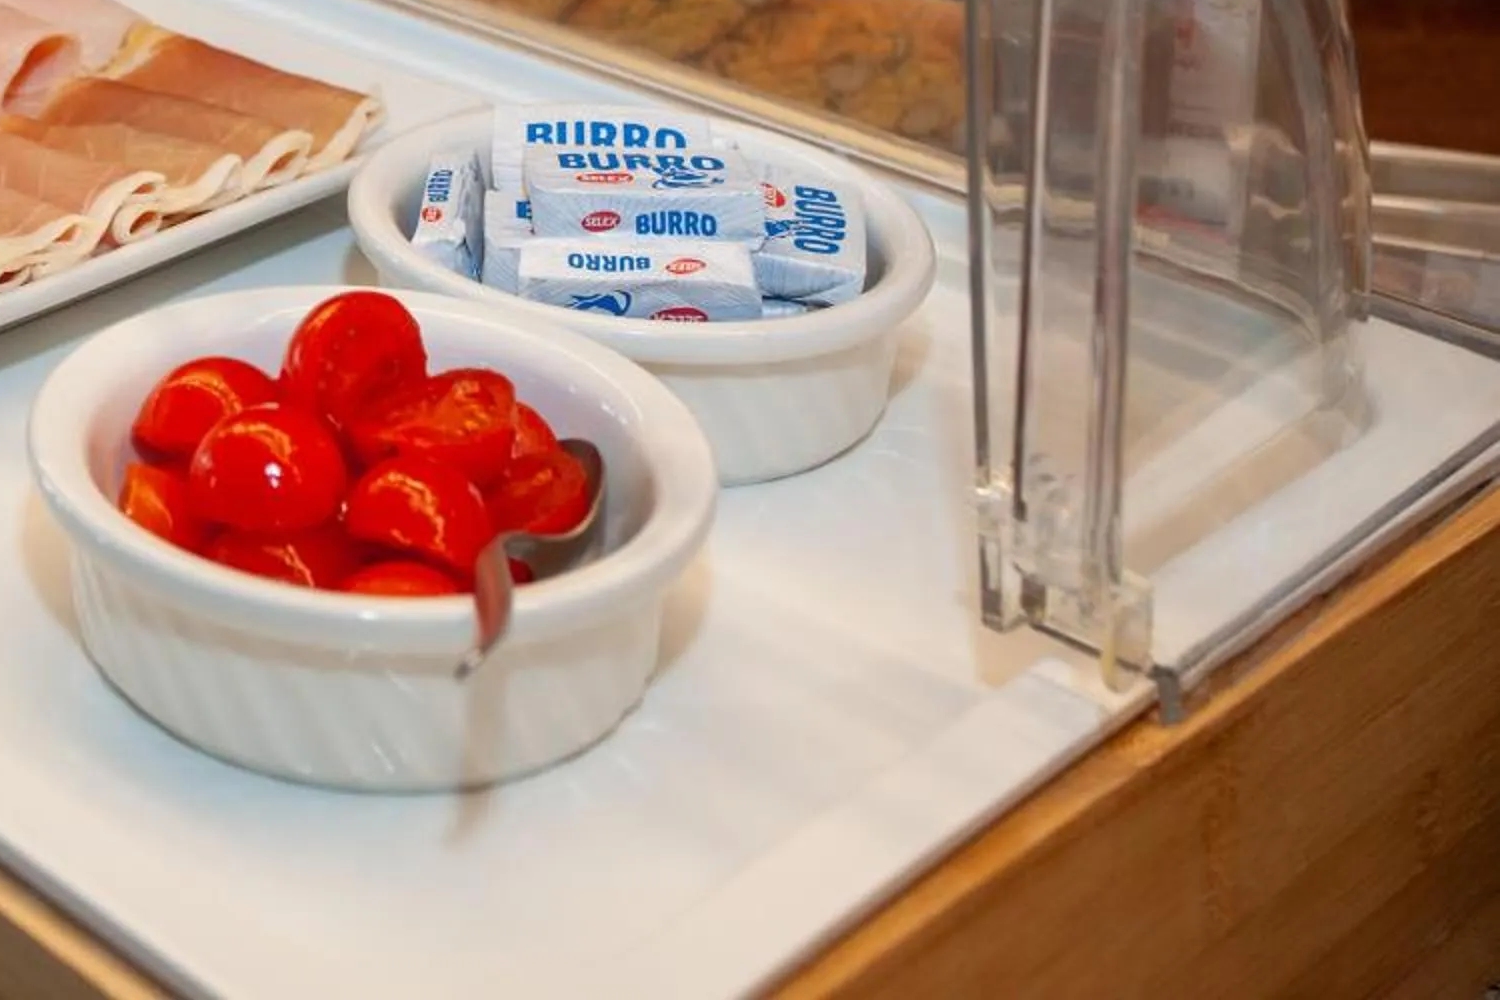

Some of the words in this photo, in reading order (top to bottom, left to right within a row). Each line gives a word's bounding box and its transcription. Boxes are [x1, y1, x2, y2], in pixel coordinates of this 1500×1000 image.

[557, 153, 725, 171] BURRO
[635, 210, 717, 236] BURRO
[794, 185, 846, 254] BURRO
[567, 253, 650, 272] BURRO
